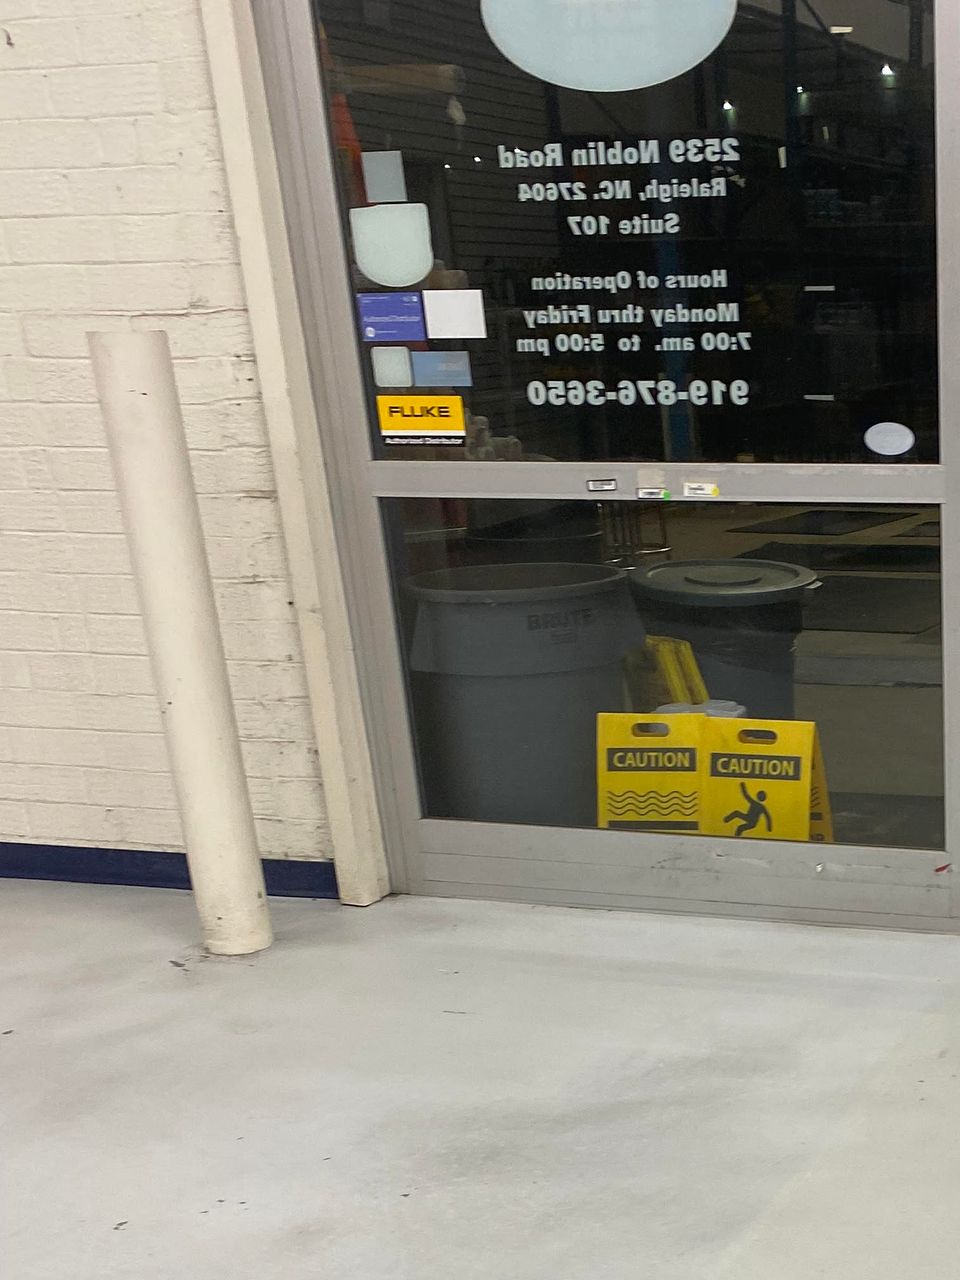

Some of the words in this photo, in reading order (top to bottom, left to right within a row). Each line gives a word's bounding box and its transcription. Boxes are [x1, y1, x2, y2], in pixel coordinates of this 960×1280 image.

[388, 406, 451, 417] FLUKE
[613, 752, 690, 768] CAUTION
[716, 757, 795, 777] CAUTION
